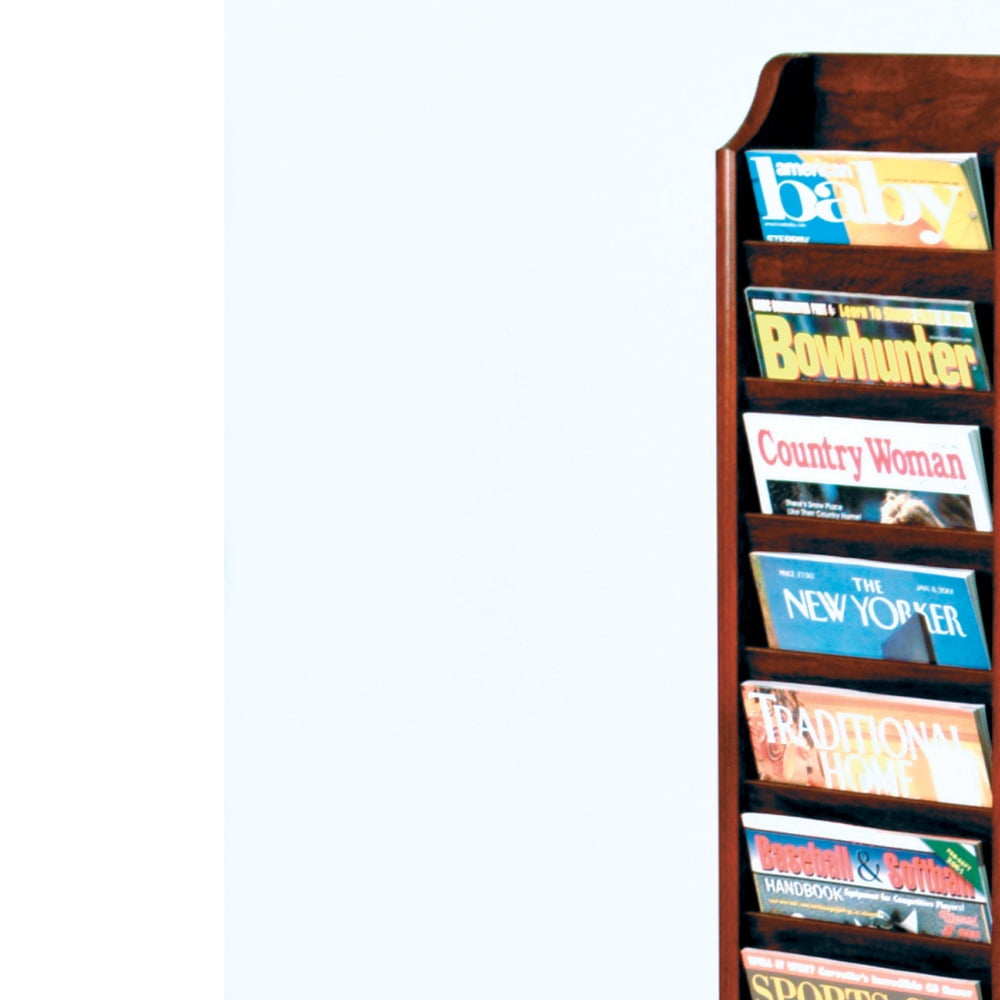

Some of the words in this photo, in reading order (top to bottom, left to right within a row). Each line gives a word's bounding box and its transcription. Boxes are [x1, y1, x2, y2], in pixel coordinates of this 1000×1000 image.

[750, 156, 964, 245] baby
[755, 313, 977, 389] Bowhunter
[758, 429, 863, 482] Country
[864, 436, 967, 480] Woman
[851, 577, 884, 594] THE
[783, 588, 847, 623] NEW
[850, 593, 967, 637] YORKER
[747, 691, 962, 761] TRADITIONAL
[820, 751, 913, 799] HOME
[754, 834, 855, 882] Baseball
[856, 850, 883, 883] &
[764, 878, 844, 901] HANDBOOK
